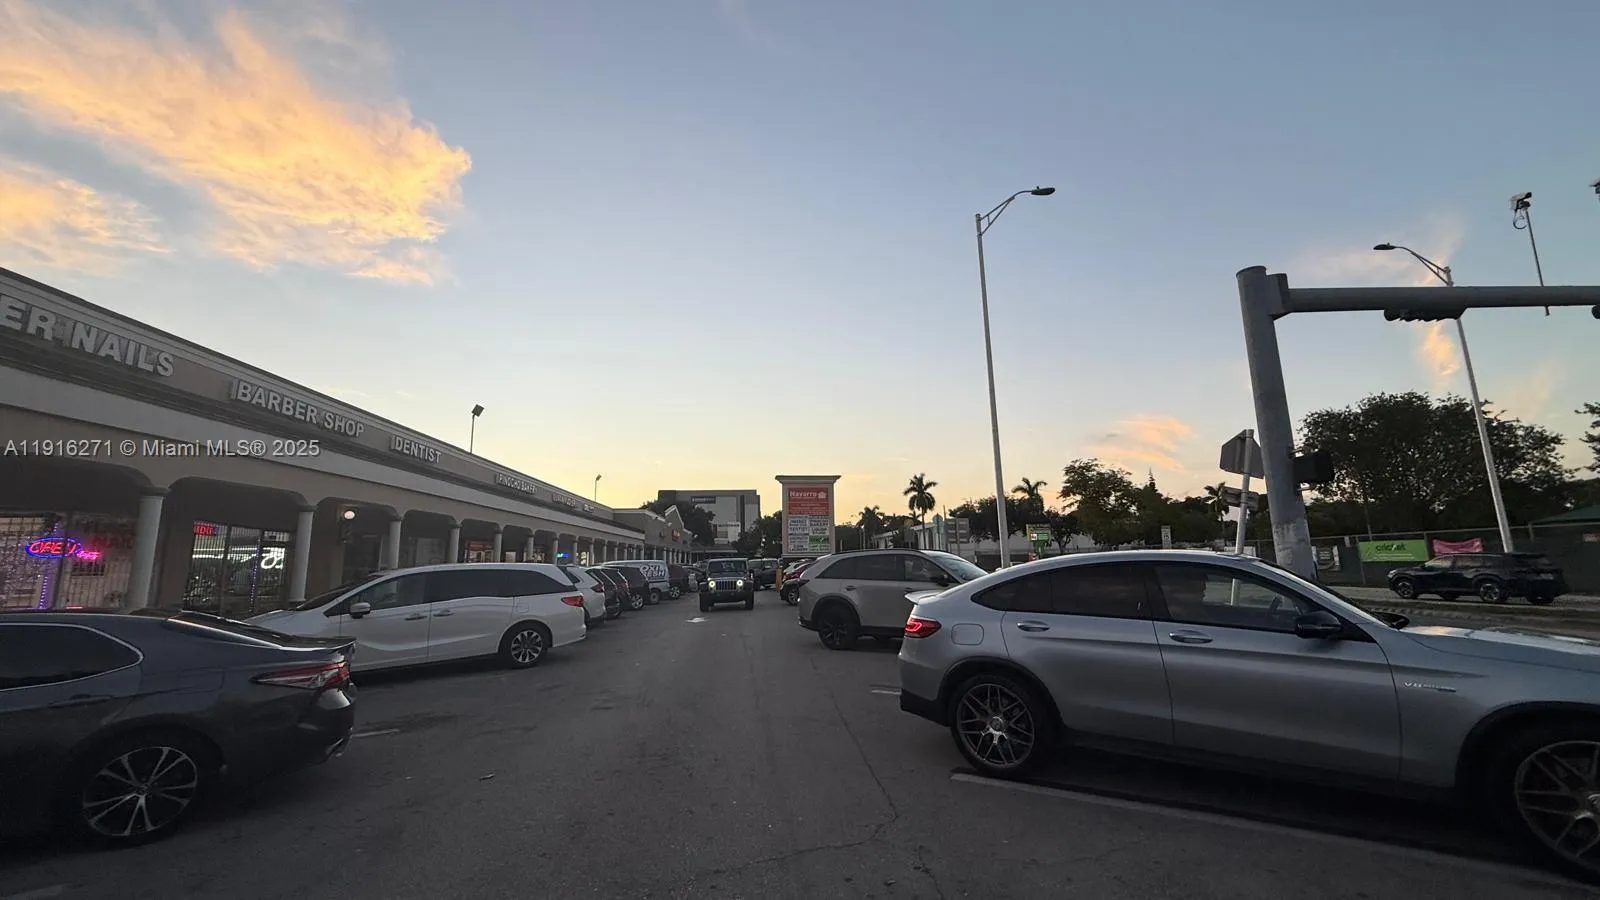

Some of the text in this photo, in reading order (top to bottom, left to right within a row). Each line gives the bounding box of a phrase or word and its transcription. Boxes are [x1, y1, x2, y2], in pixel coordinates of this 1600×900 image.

[71, 320, 174, 377] NAILS
[236, 379, 365, 437] BARBER SHOP
[394, 435, 442, 464] DENTIST
